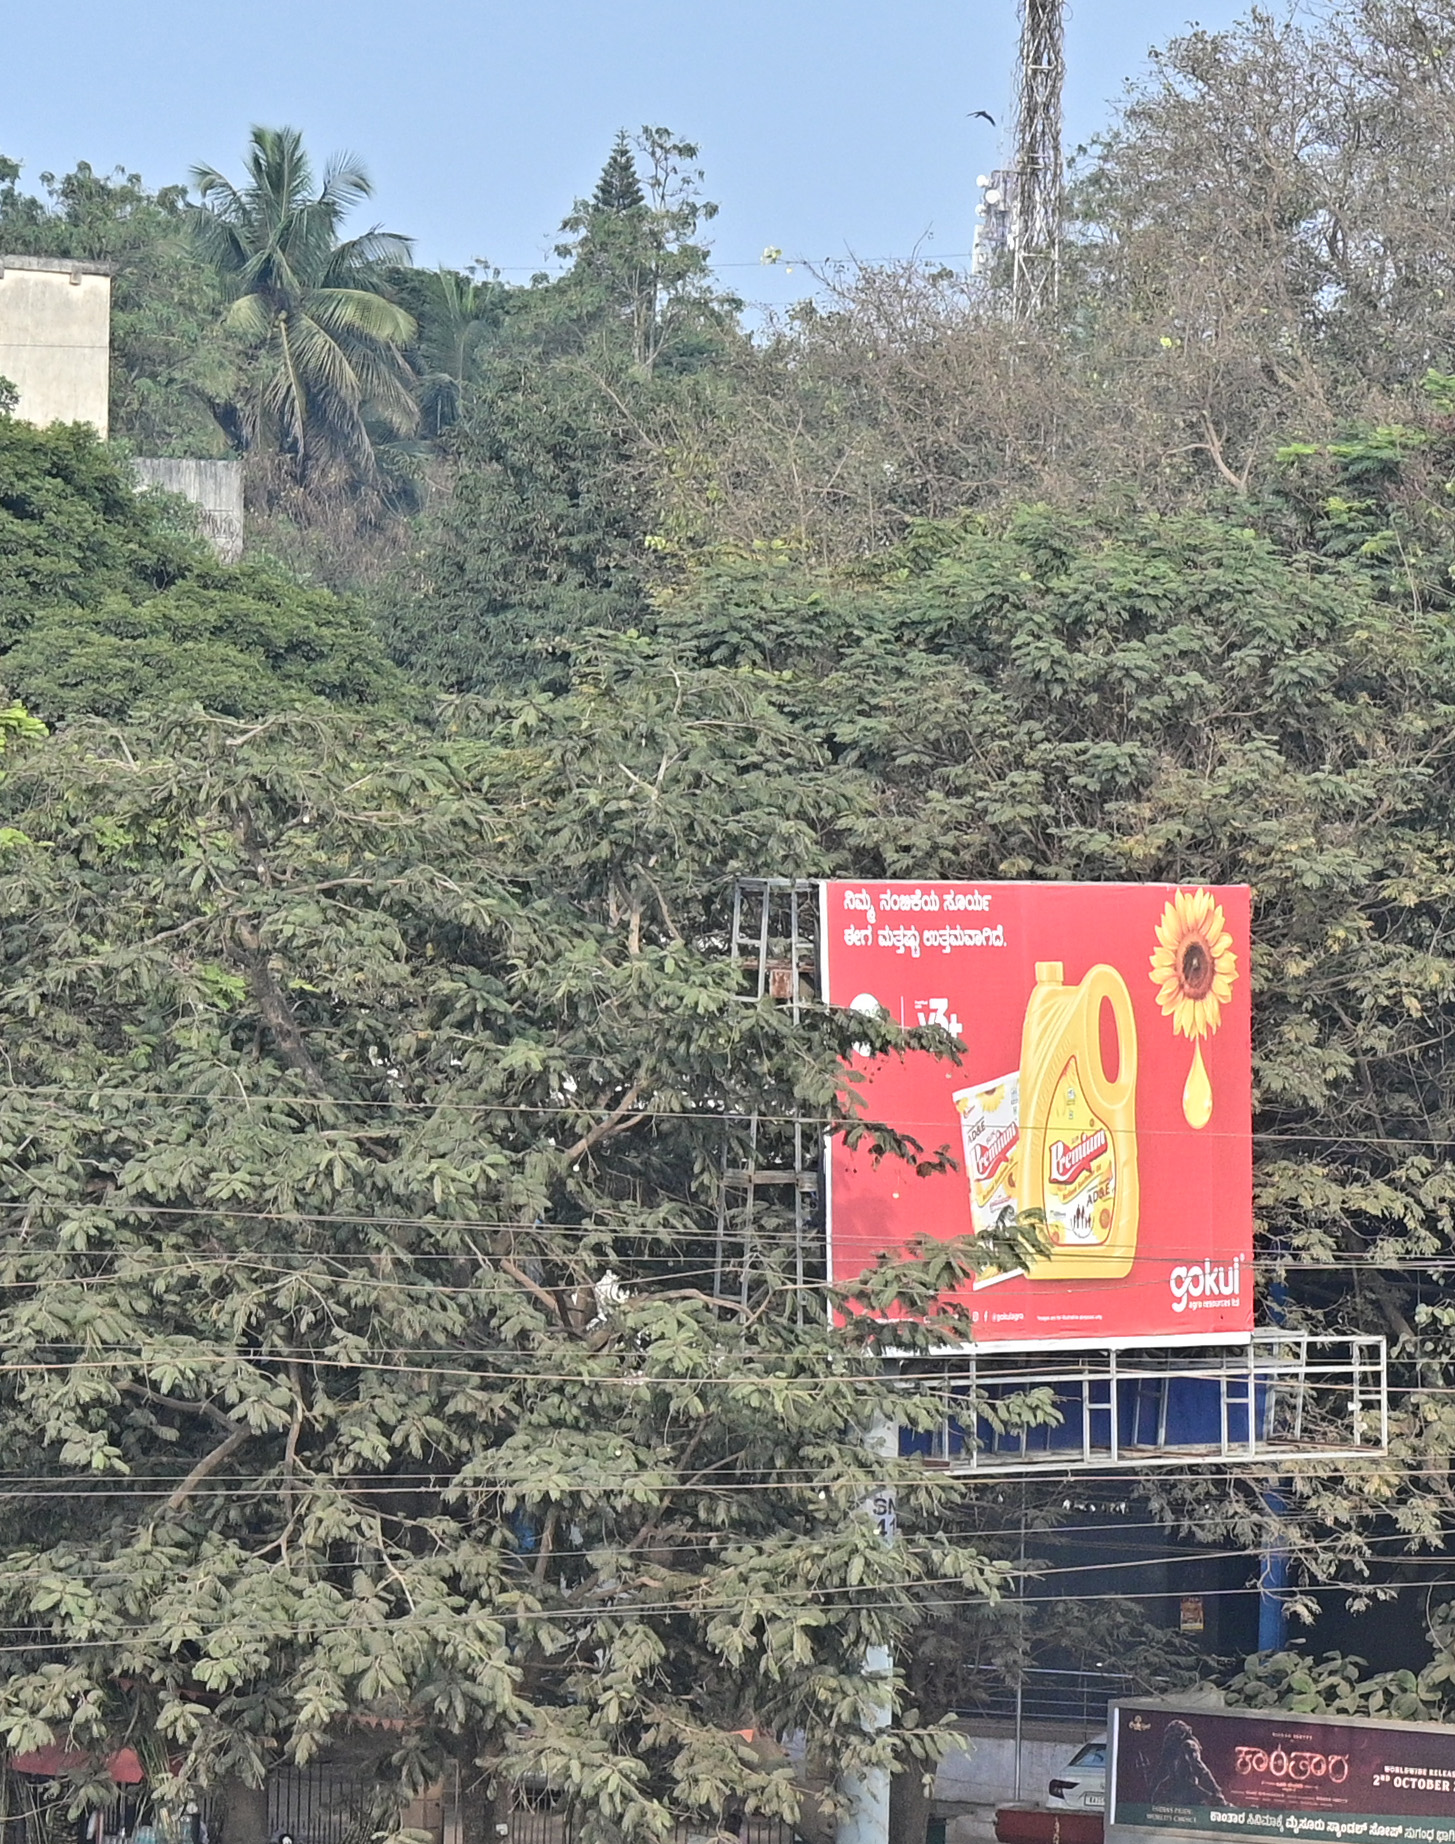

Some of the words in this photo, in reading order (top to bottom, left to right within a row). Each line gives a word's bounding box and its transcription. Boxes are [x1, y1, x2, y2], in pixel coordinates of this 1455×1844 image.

[974, 1122, 1018, 1174] Premium
[1050, 1131, 1107, 1173] Premium
[1235, 1744, 1349, 1784] ಕಾಂತಾರ
[1384, 1765, 1427, 1776] WORLDWIDE
[1393, 1777, 1450, 1792] OCTOBER
[1210, 1811, 1245, 1825] ಕಾಂತಾರ
[1285, 1817, 1326, 1834] ಮೈಸೂರು
[1404, 1826, 1435, 1843] ಸುಗಂಧ
